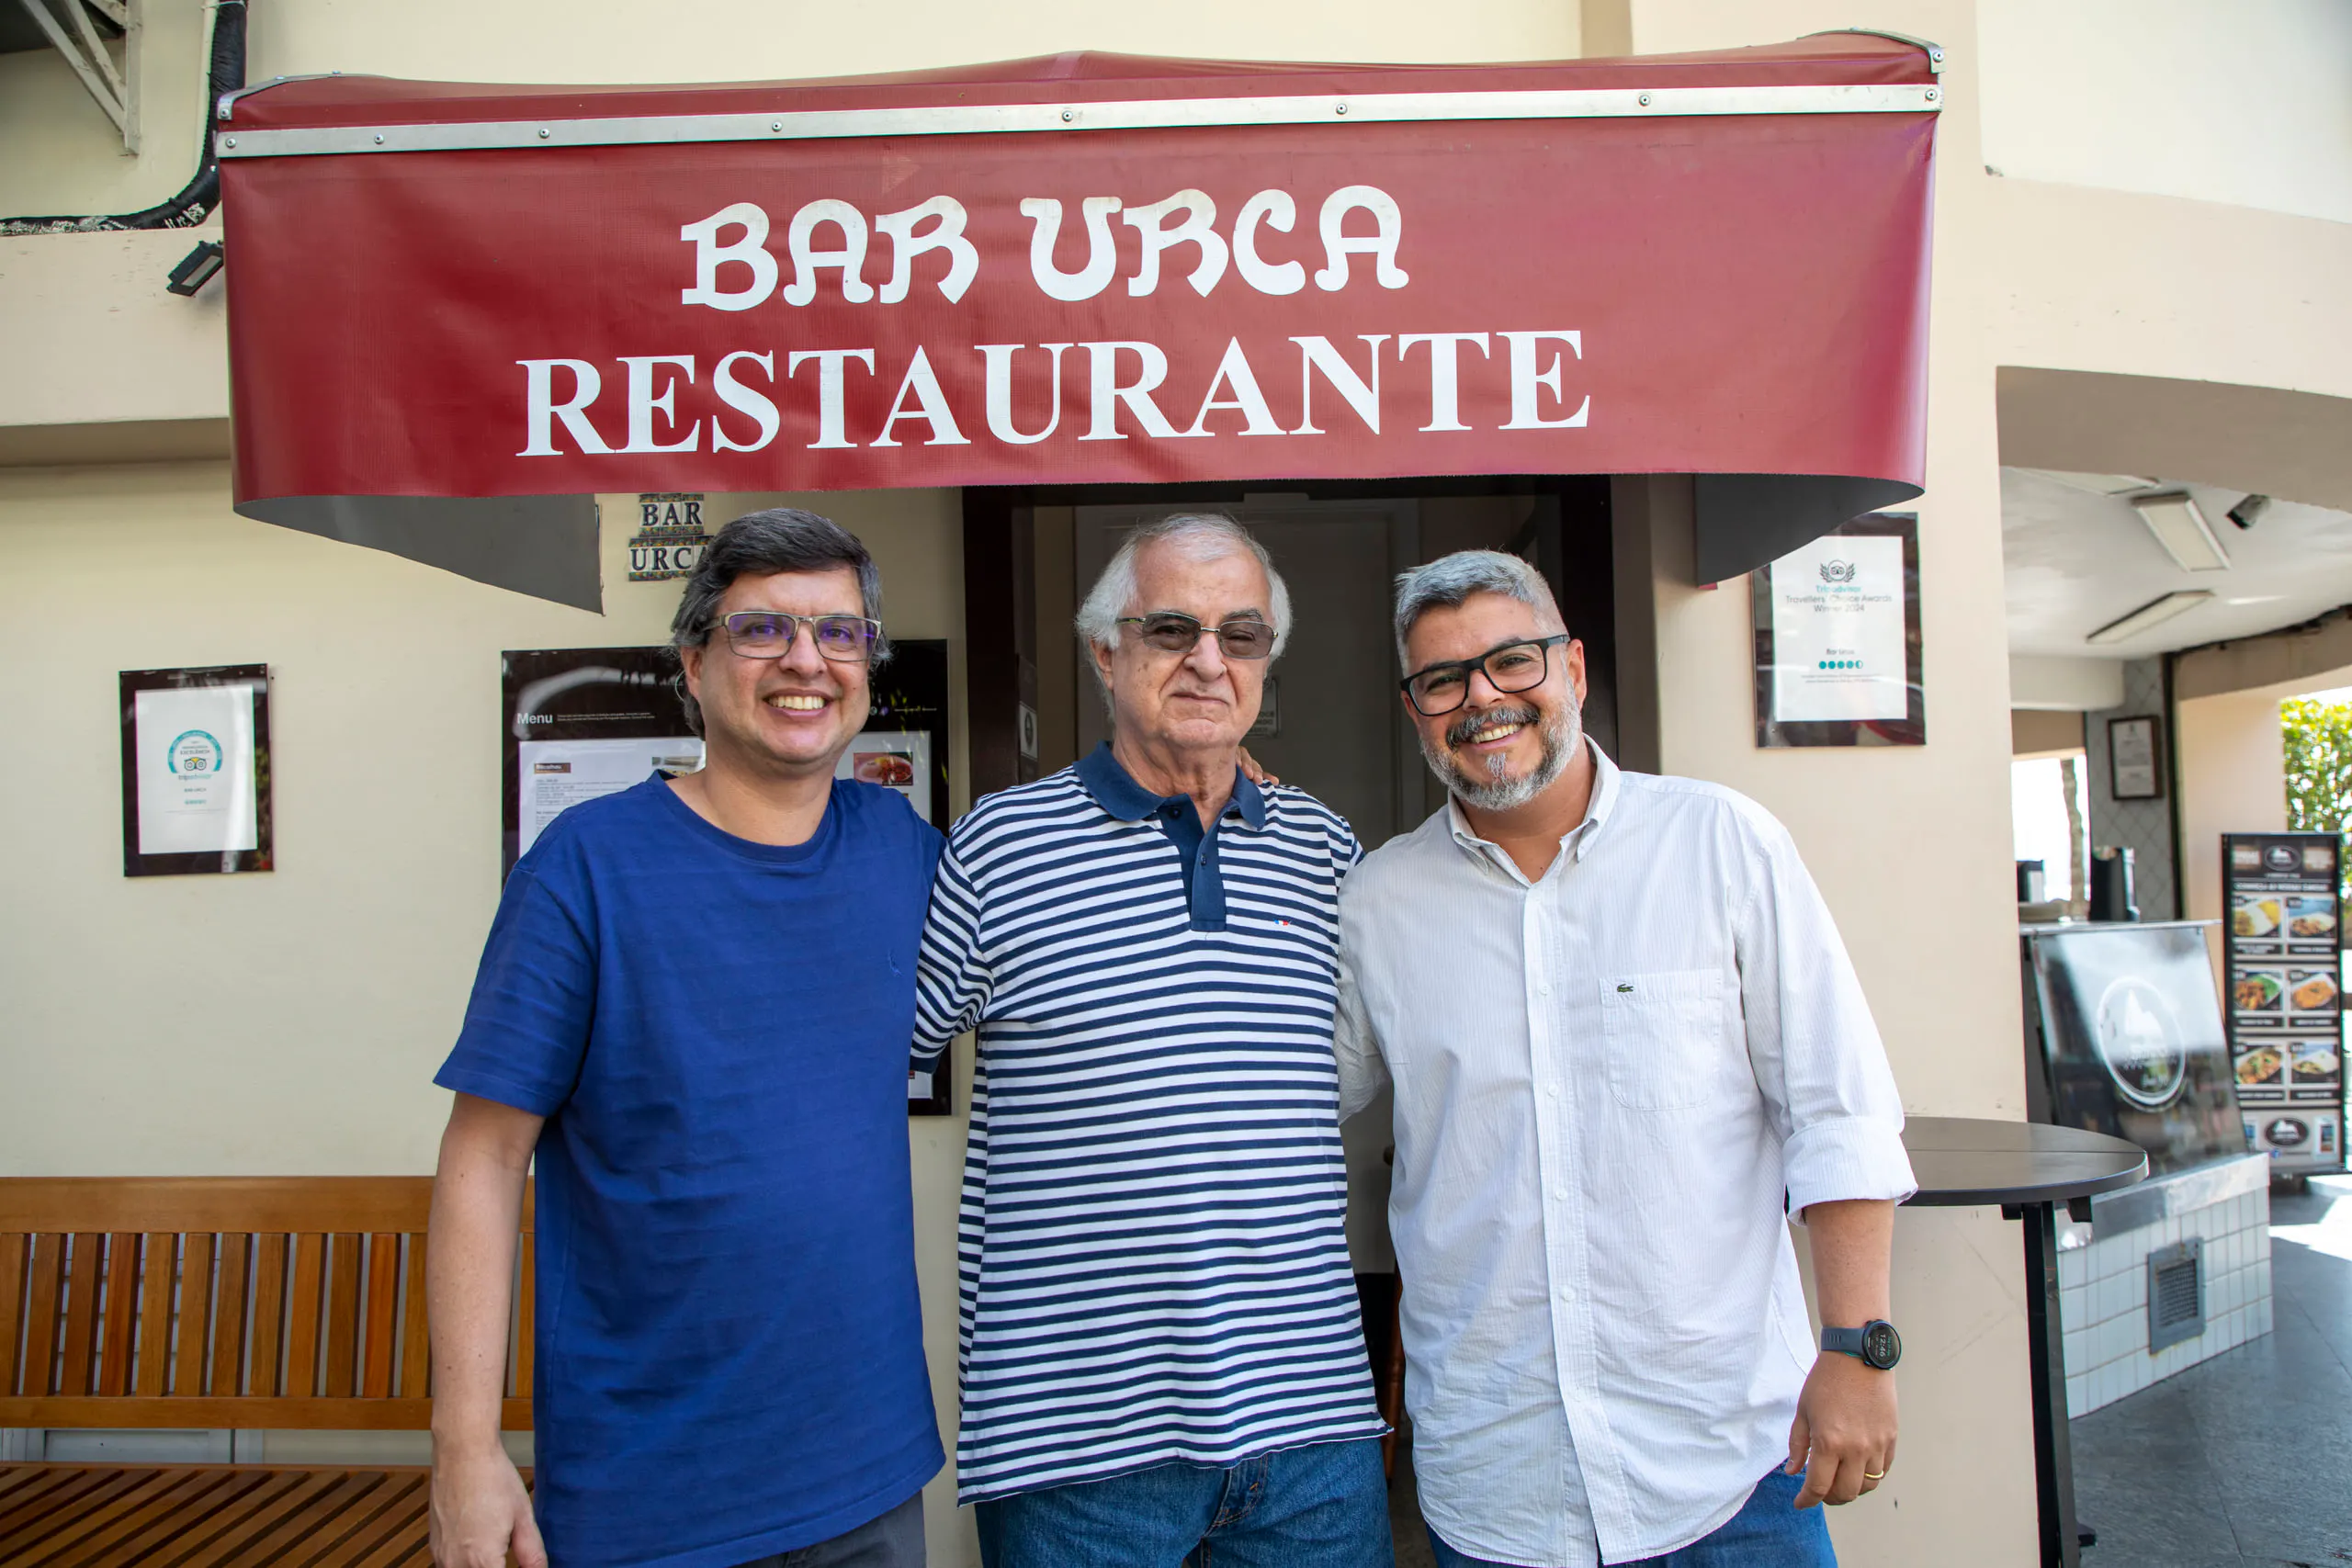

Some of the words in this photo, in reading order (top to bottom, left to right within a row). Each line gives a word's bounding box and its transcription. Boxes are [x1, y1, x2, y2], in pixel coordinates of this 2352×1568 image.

[680, 195, 979, 311] BAR
[1020, 184, 1410, 302] URCA
[515, 329, 1591, 457] RESTAURANTE
[640, 502, 703, 526] BAR
[517, 713, 553, 724] Menu
